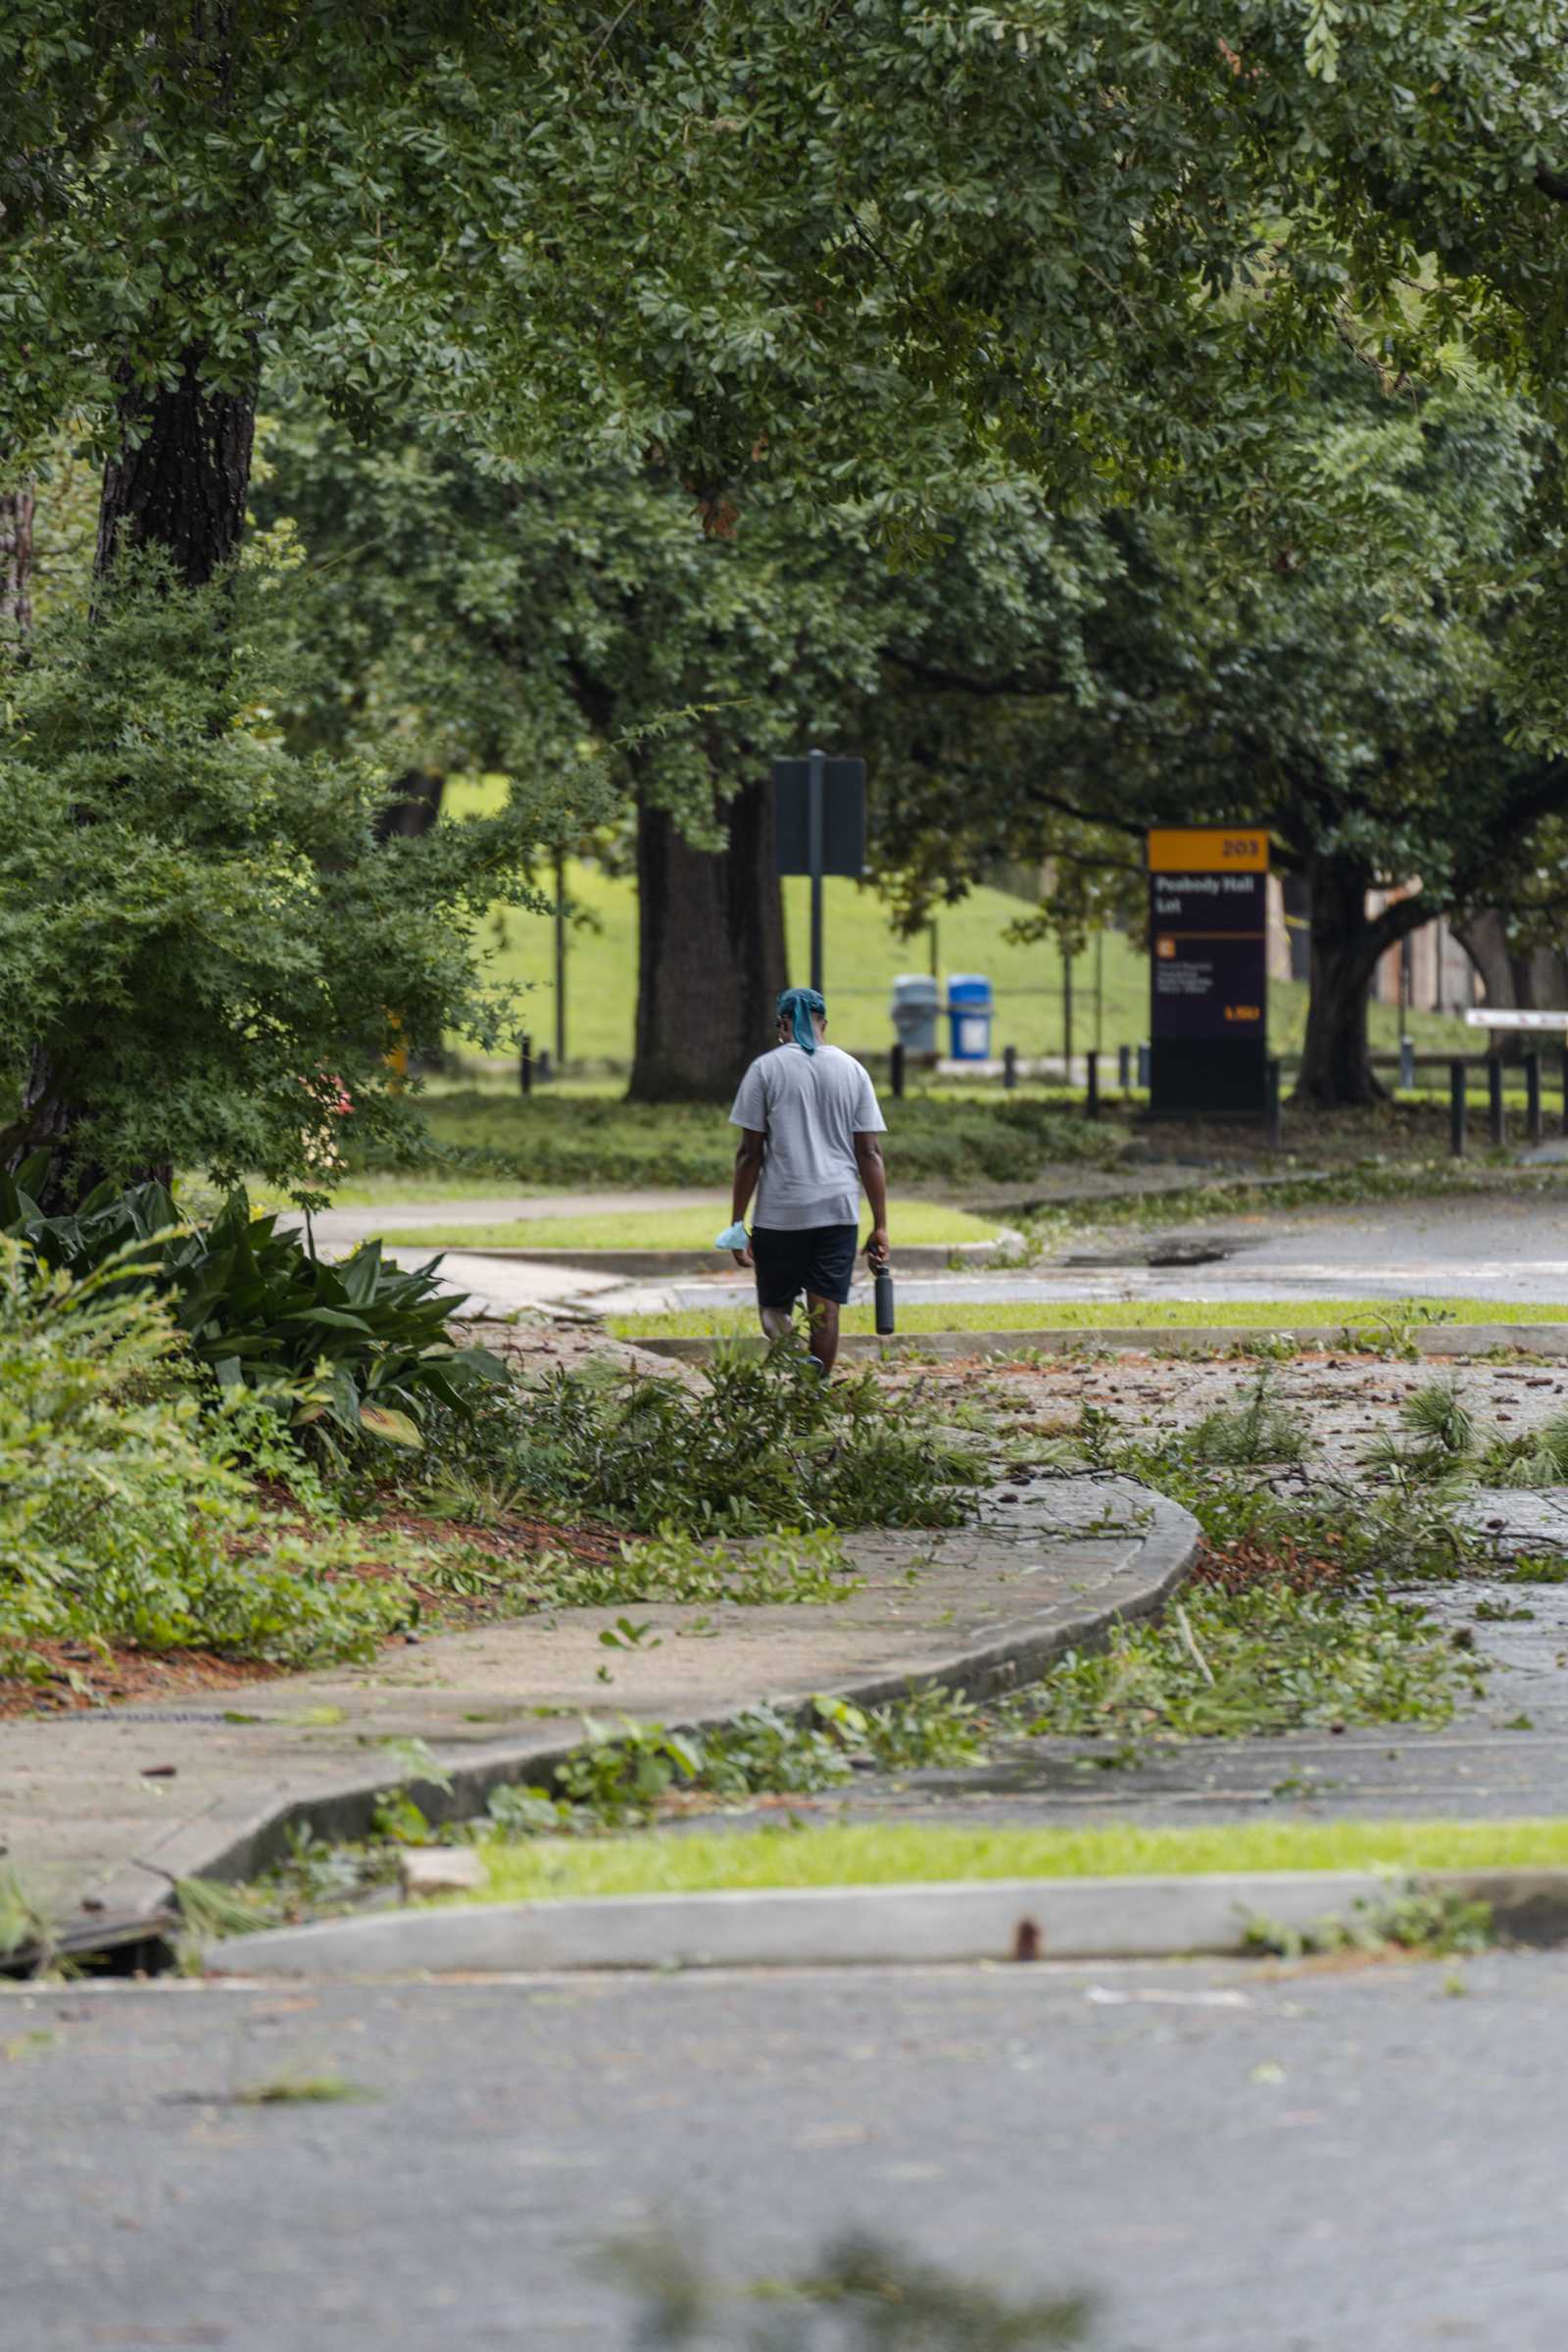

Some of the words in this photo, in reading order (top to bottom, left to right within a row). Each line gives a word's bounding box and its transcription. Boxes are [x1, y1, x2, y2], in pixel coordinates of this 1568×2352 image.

[1157, 876, 1219, 896] Peabody
[1223, 876, 1254, 893] Hall
[1157, 897, 1181, 912] Lot
